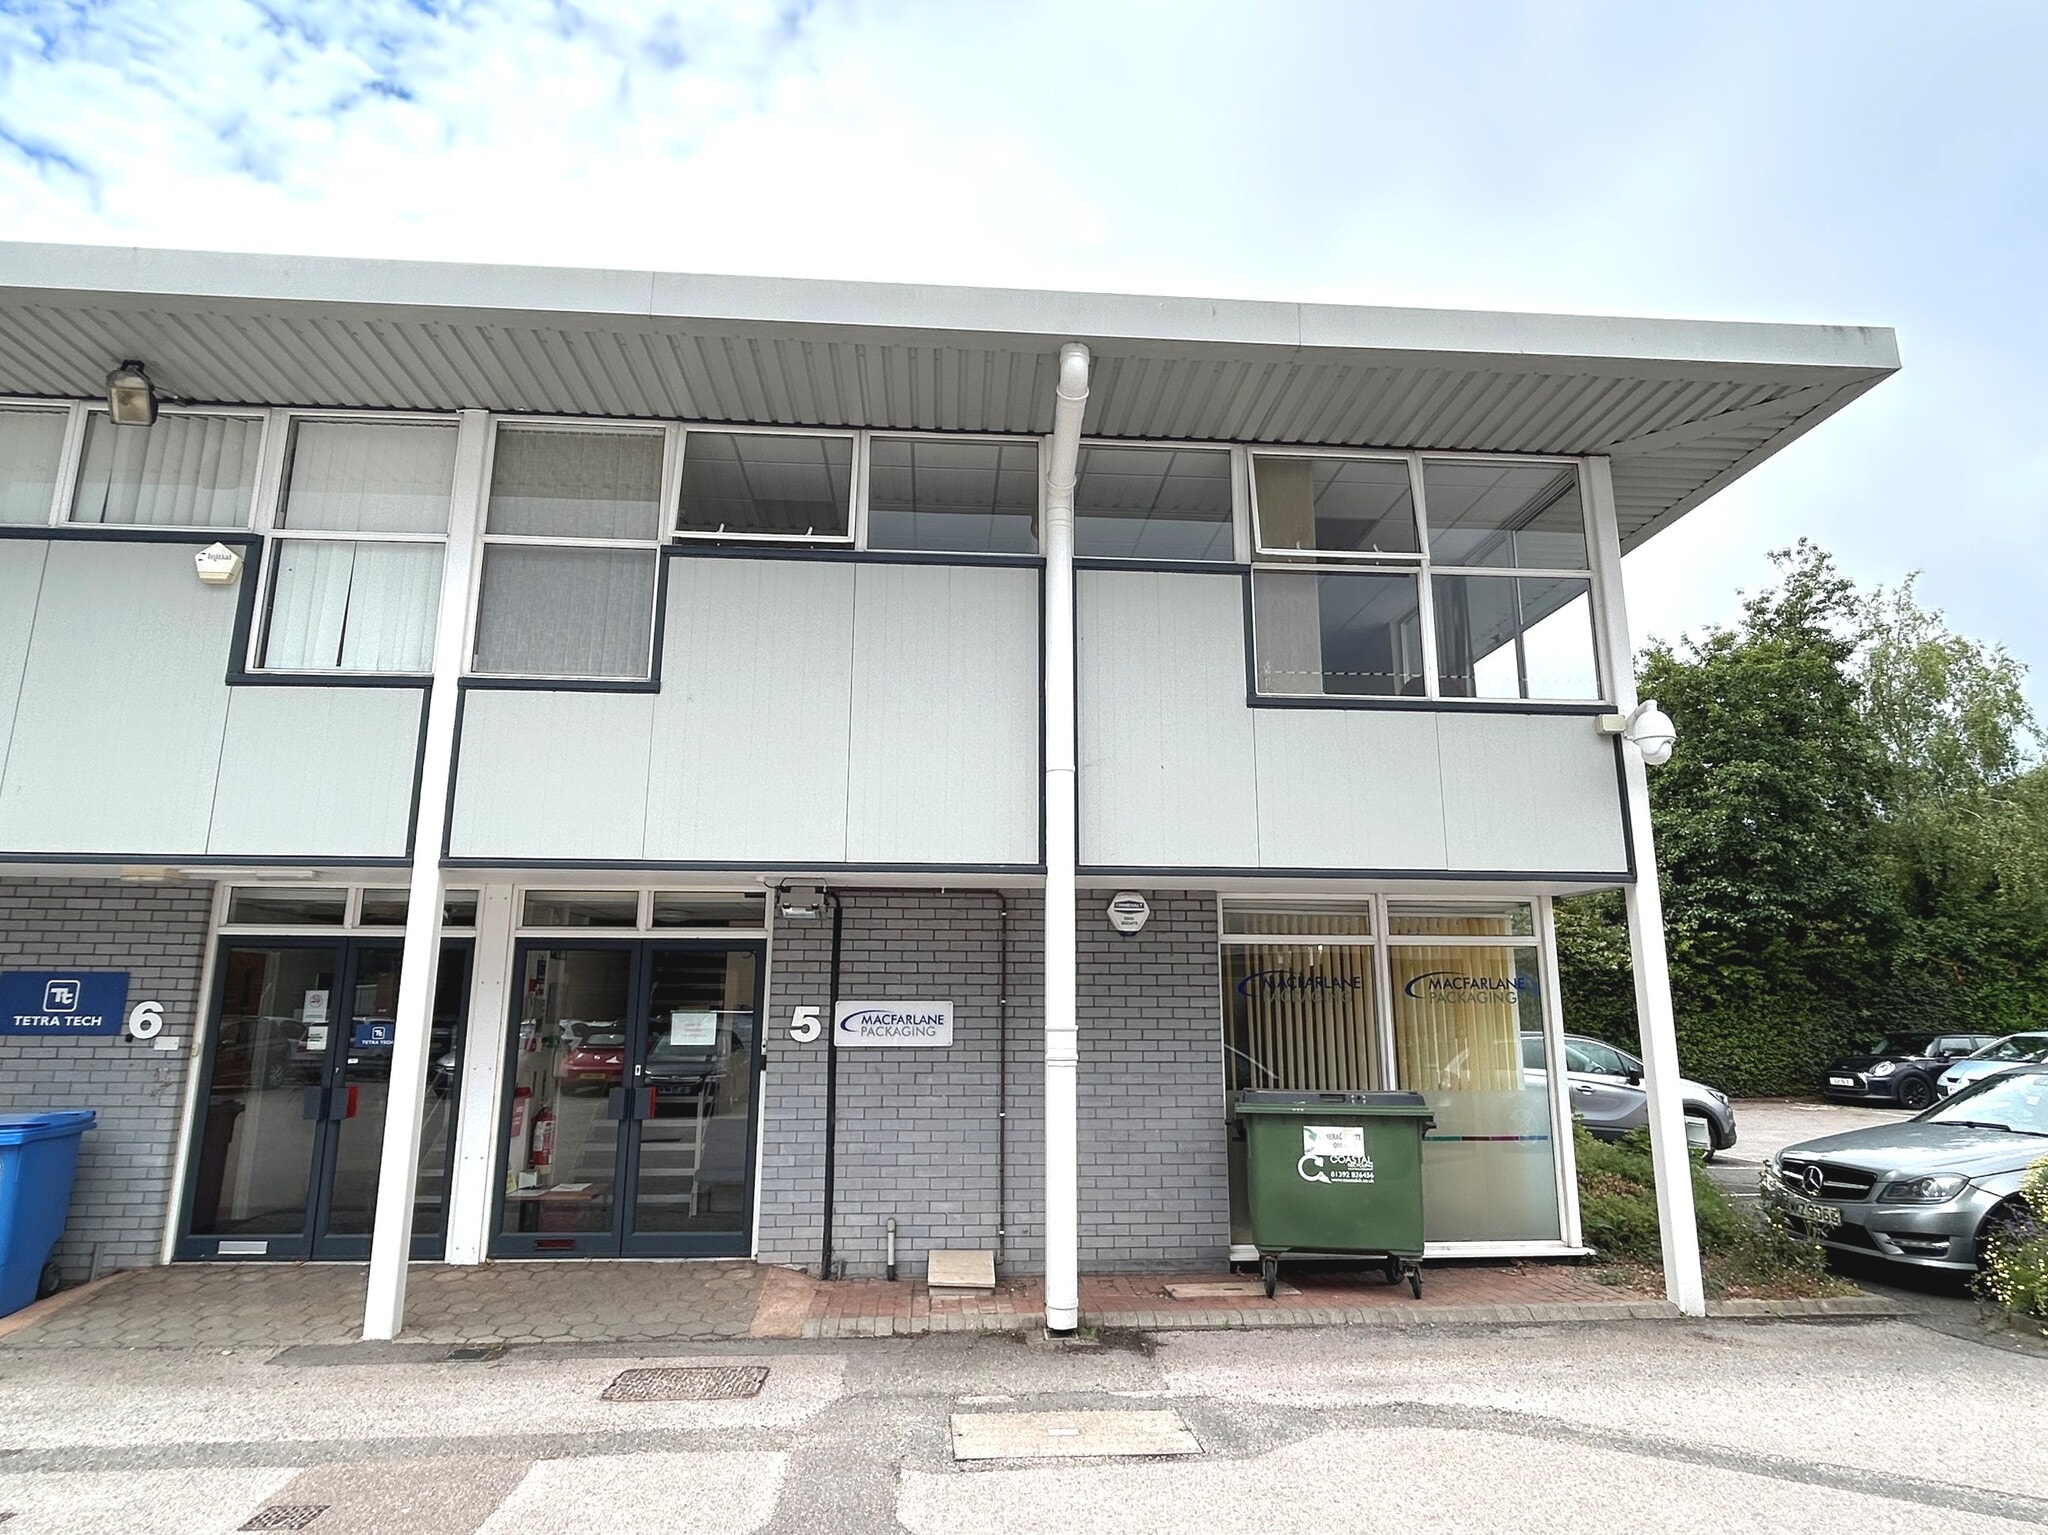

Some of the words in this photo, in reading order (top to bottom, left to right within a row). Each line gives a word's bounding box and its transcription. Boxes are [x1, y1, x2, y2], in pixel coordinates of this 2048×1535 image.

[207, 552, 232, 561] Initial
[1263, 976, 1361, 990] MACFARLANE
[1428, 977, 1525, 990] MACFARLANE
[1429, 991, 1517, 1004] PACKAGING
[13, 1015, 60, 1026] TETRA
[64, 1015, 102, 1026] TECH
[129, 1001, 164, 1040] 6
[790, 1005, 822, 1043] 5
[861, 1014, 944, 1026] MACFARLANE
[860, 1026, 936, 1037] PACKAGING
[1330, 1155, 1373, 1163] COASTAL
